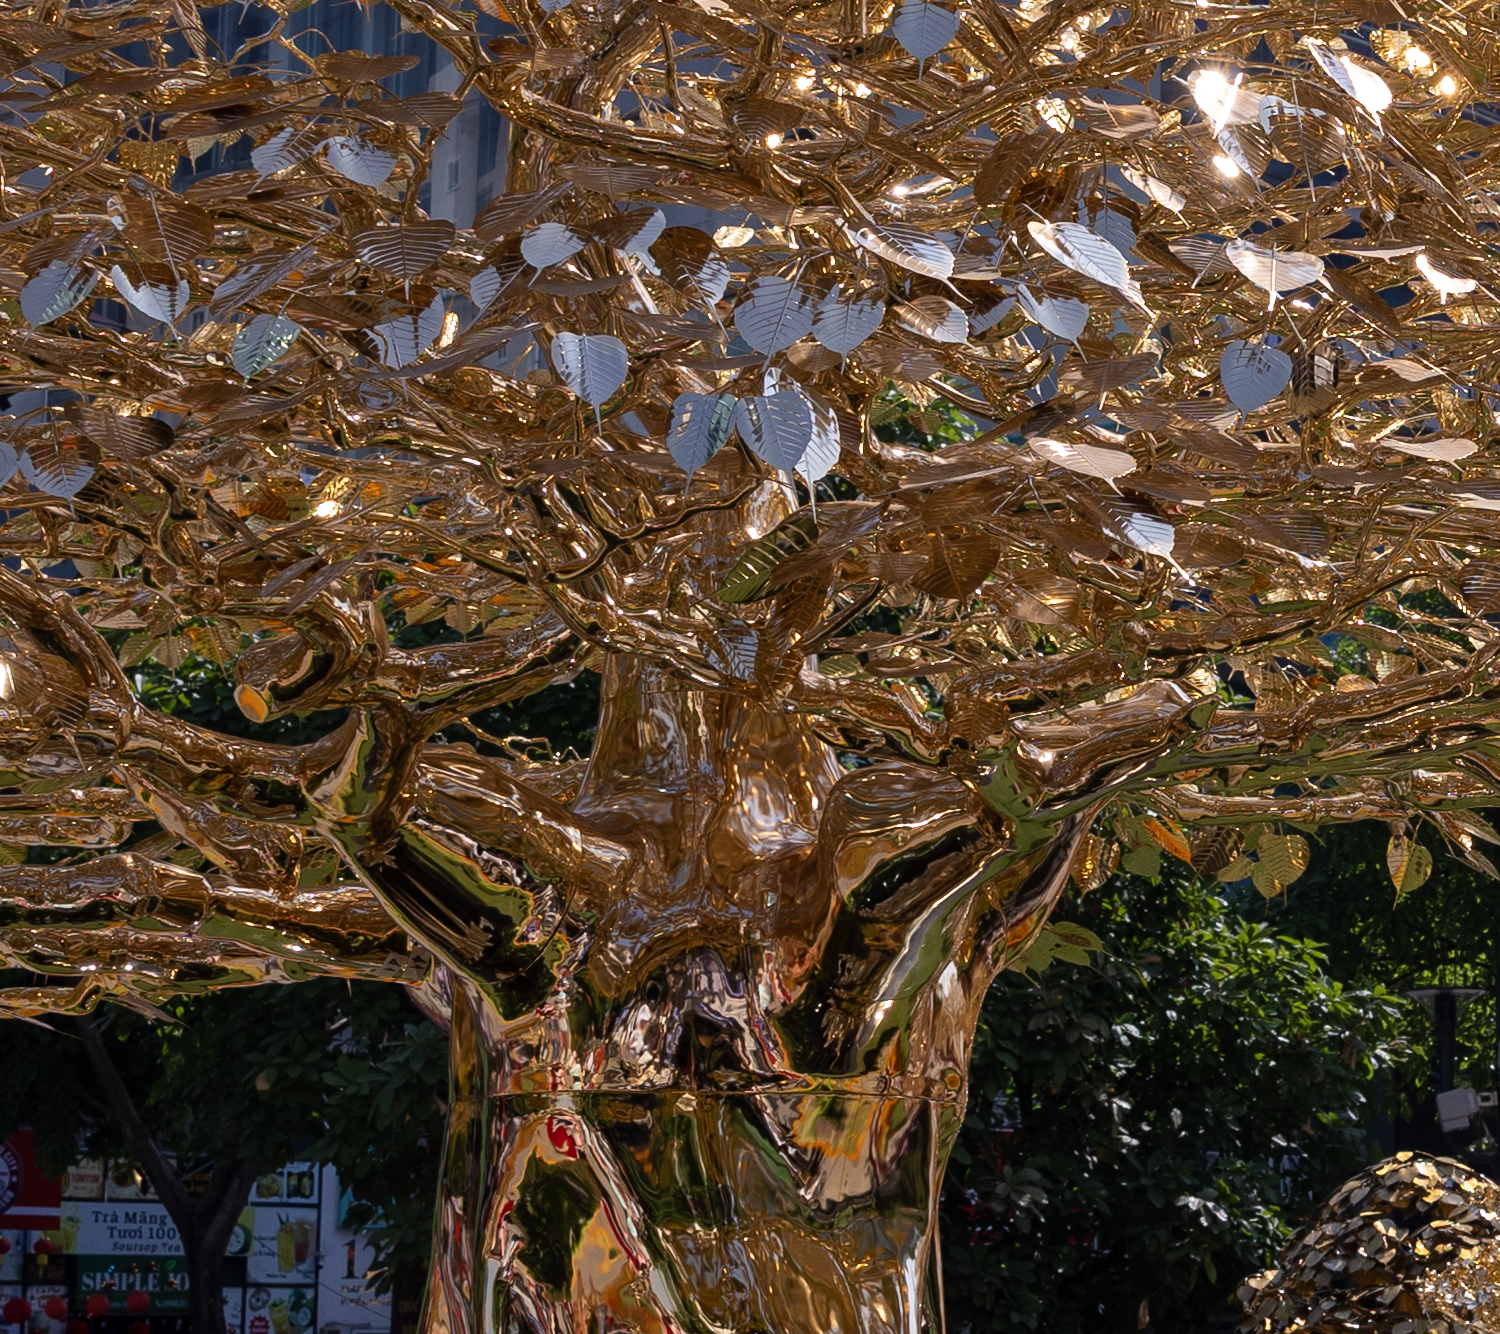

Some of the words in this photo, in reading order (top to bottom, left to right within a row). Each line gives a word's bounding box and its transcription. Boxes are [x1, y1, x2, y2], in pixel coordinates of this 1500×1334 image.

[92, 1210, 119, 1224] Trà
[124, 1211, 168, 1227] Mãng
[107, 1226, 143, 1239] Tươi
[112, 1241, 158, 1253] Soursop
[161, 1242, 181, 1252] Tea
[81, 1272, 160, 1292] SIMPLE
